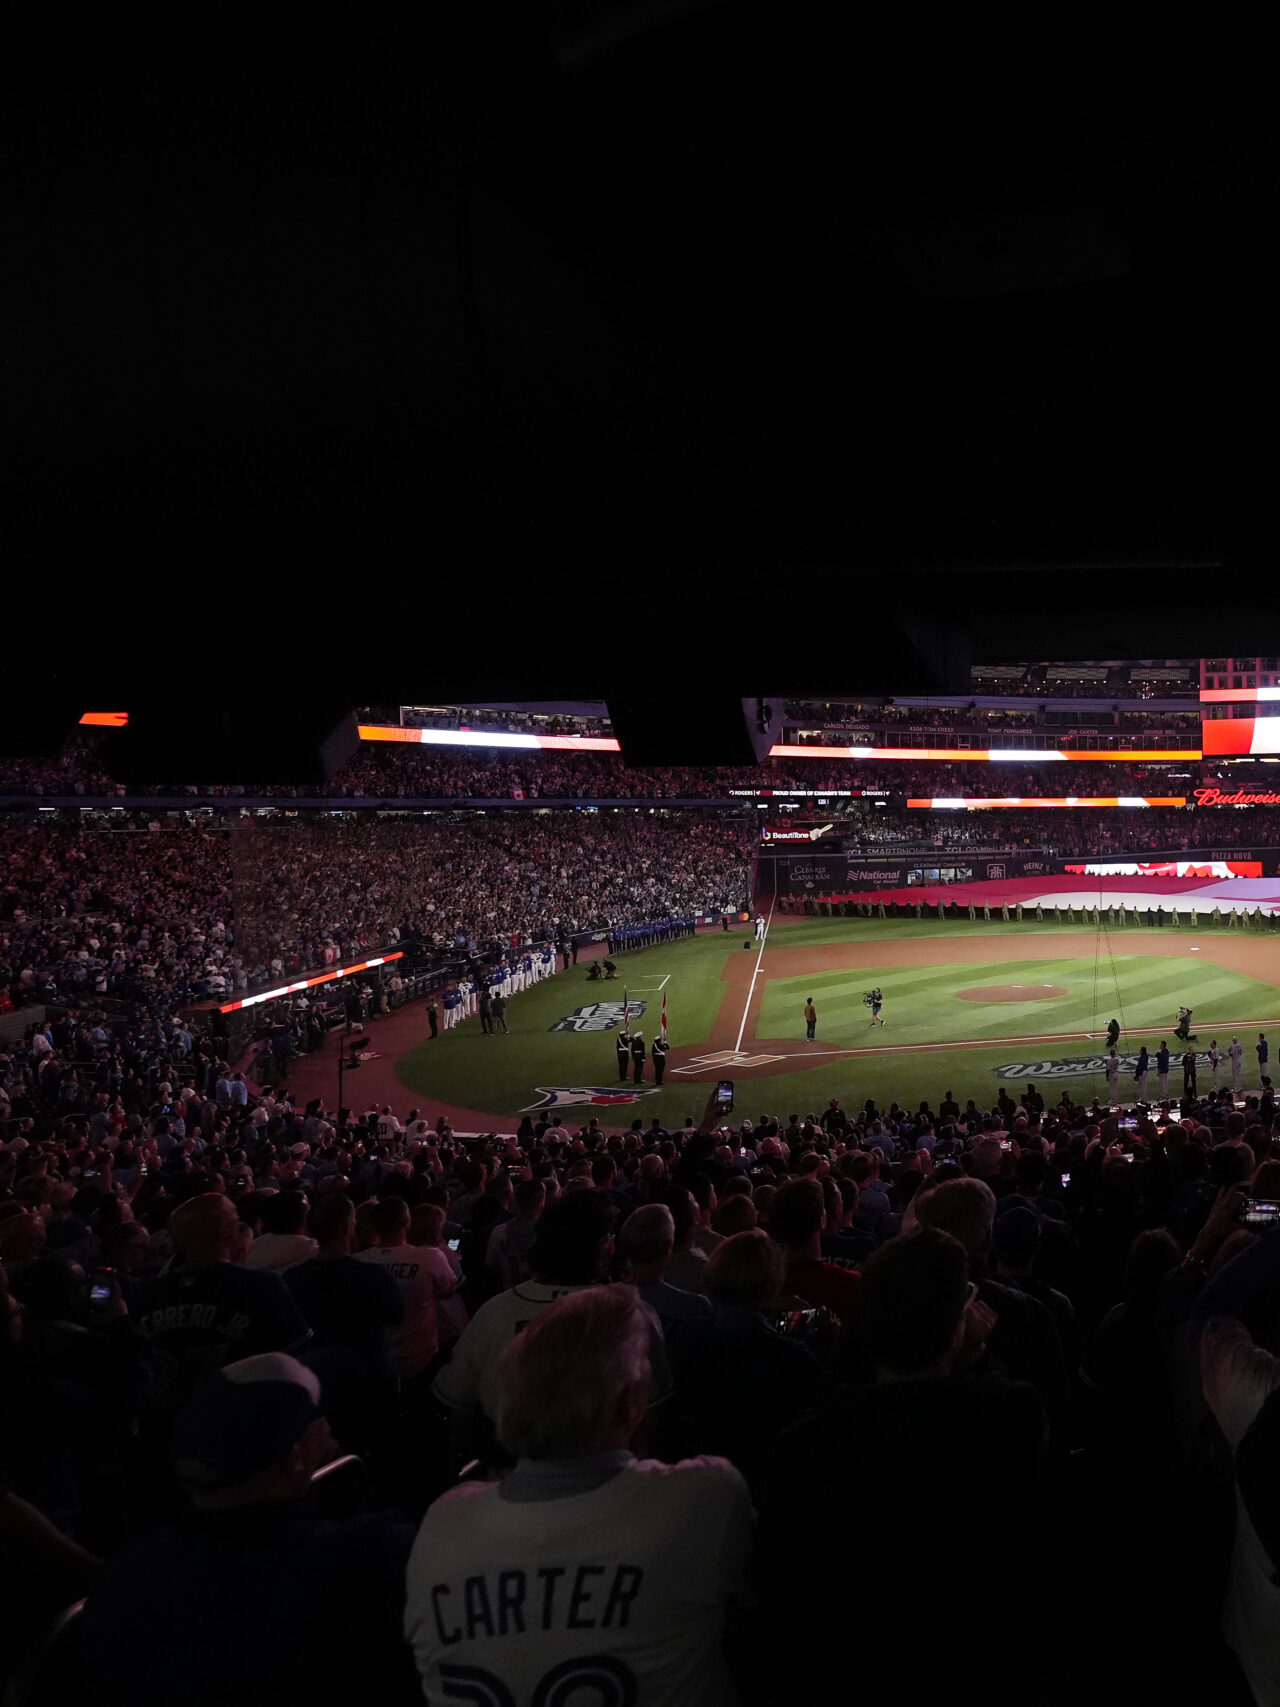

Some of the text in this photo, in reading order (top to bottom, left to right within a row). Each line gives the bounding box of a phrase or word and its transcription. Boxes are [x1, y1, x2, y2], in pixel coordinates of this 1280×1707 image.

[772, 831, 810, 839] BeautiTone
[1211, 852, 1252, 860] PIZZA NOVA
[794, 865, 827, 874] CLEARLY
[1023, 862, 1044, 871] HEINZ
[789, 873, 830, 881] CANADIAN
[859, 870, 900, 881] National
[384, 1263, 419, 1280] GER
[138, 1303, 218, 1340] ERRERO
[431, 1565, 645, 1646] CARTER
